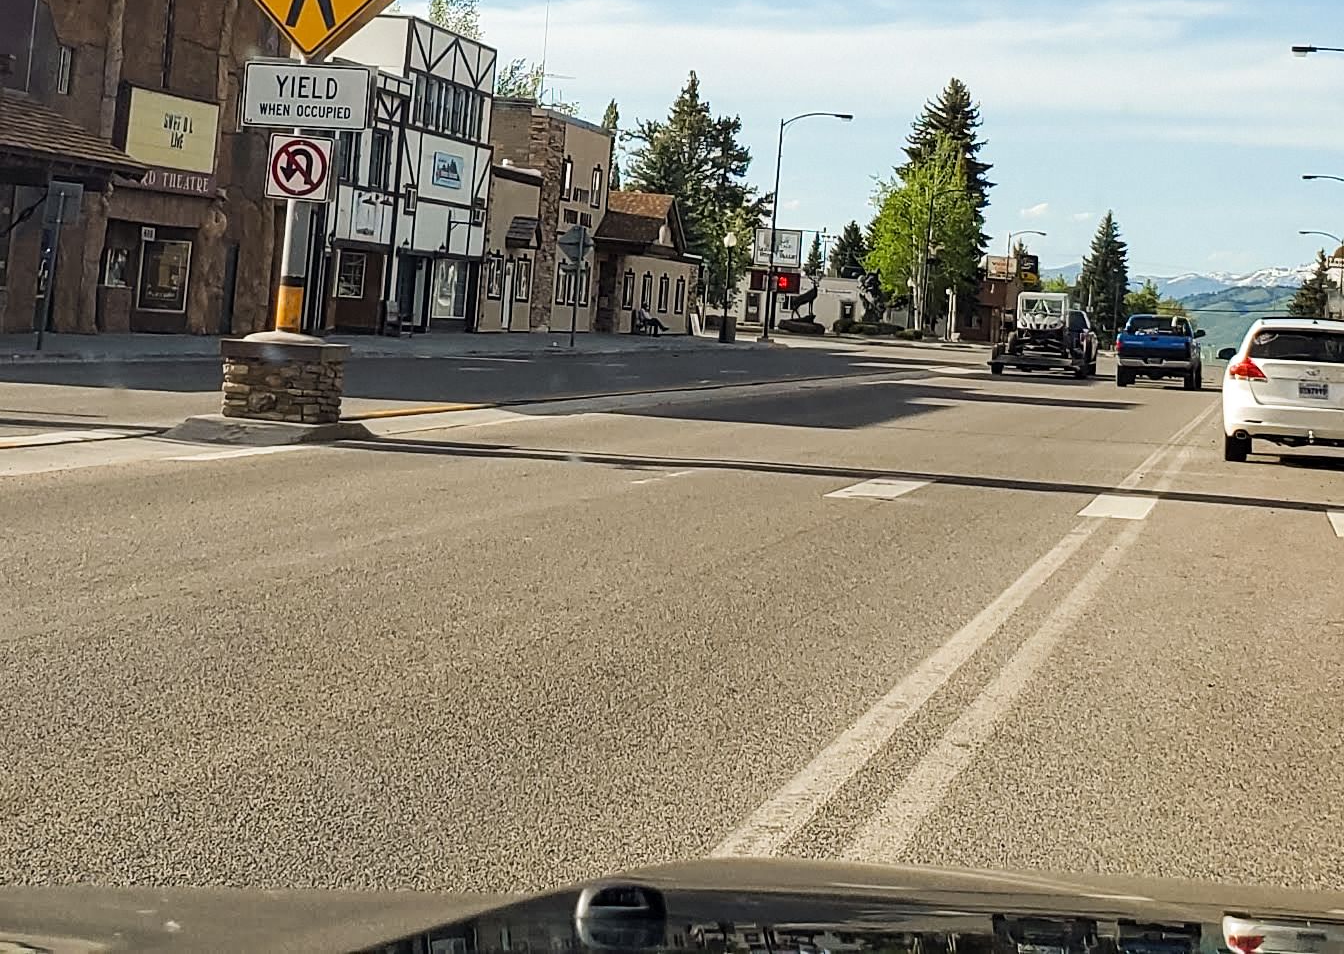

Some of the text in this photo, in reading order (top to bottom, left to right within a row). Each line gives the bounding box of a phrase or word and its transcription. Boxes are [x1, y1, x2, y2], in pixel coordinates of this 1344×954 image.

[276, 75, 338, 100] YIELD
[259, 102, 351, 120] WHEN OCCUPIED
[163, 172, 209, 193] THEATRE
